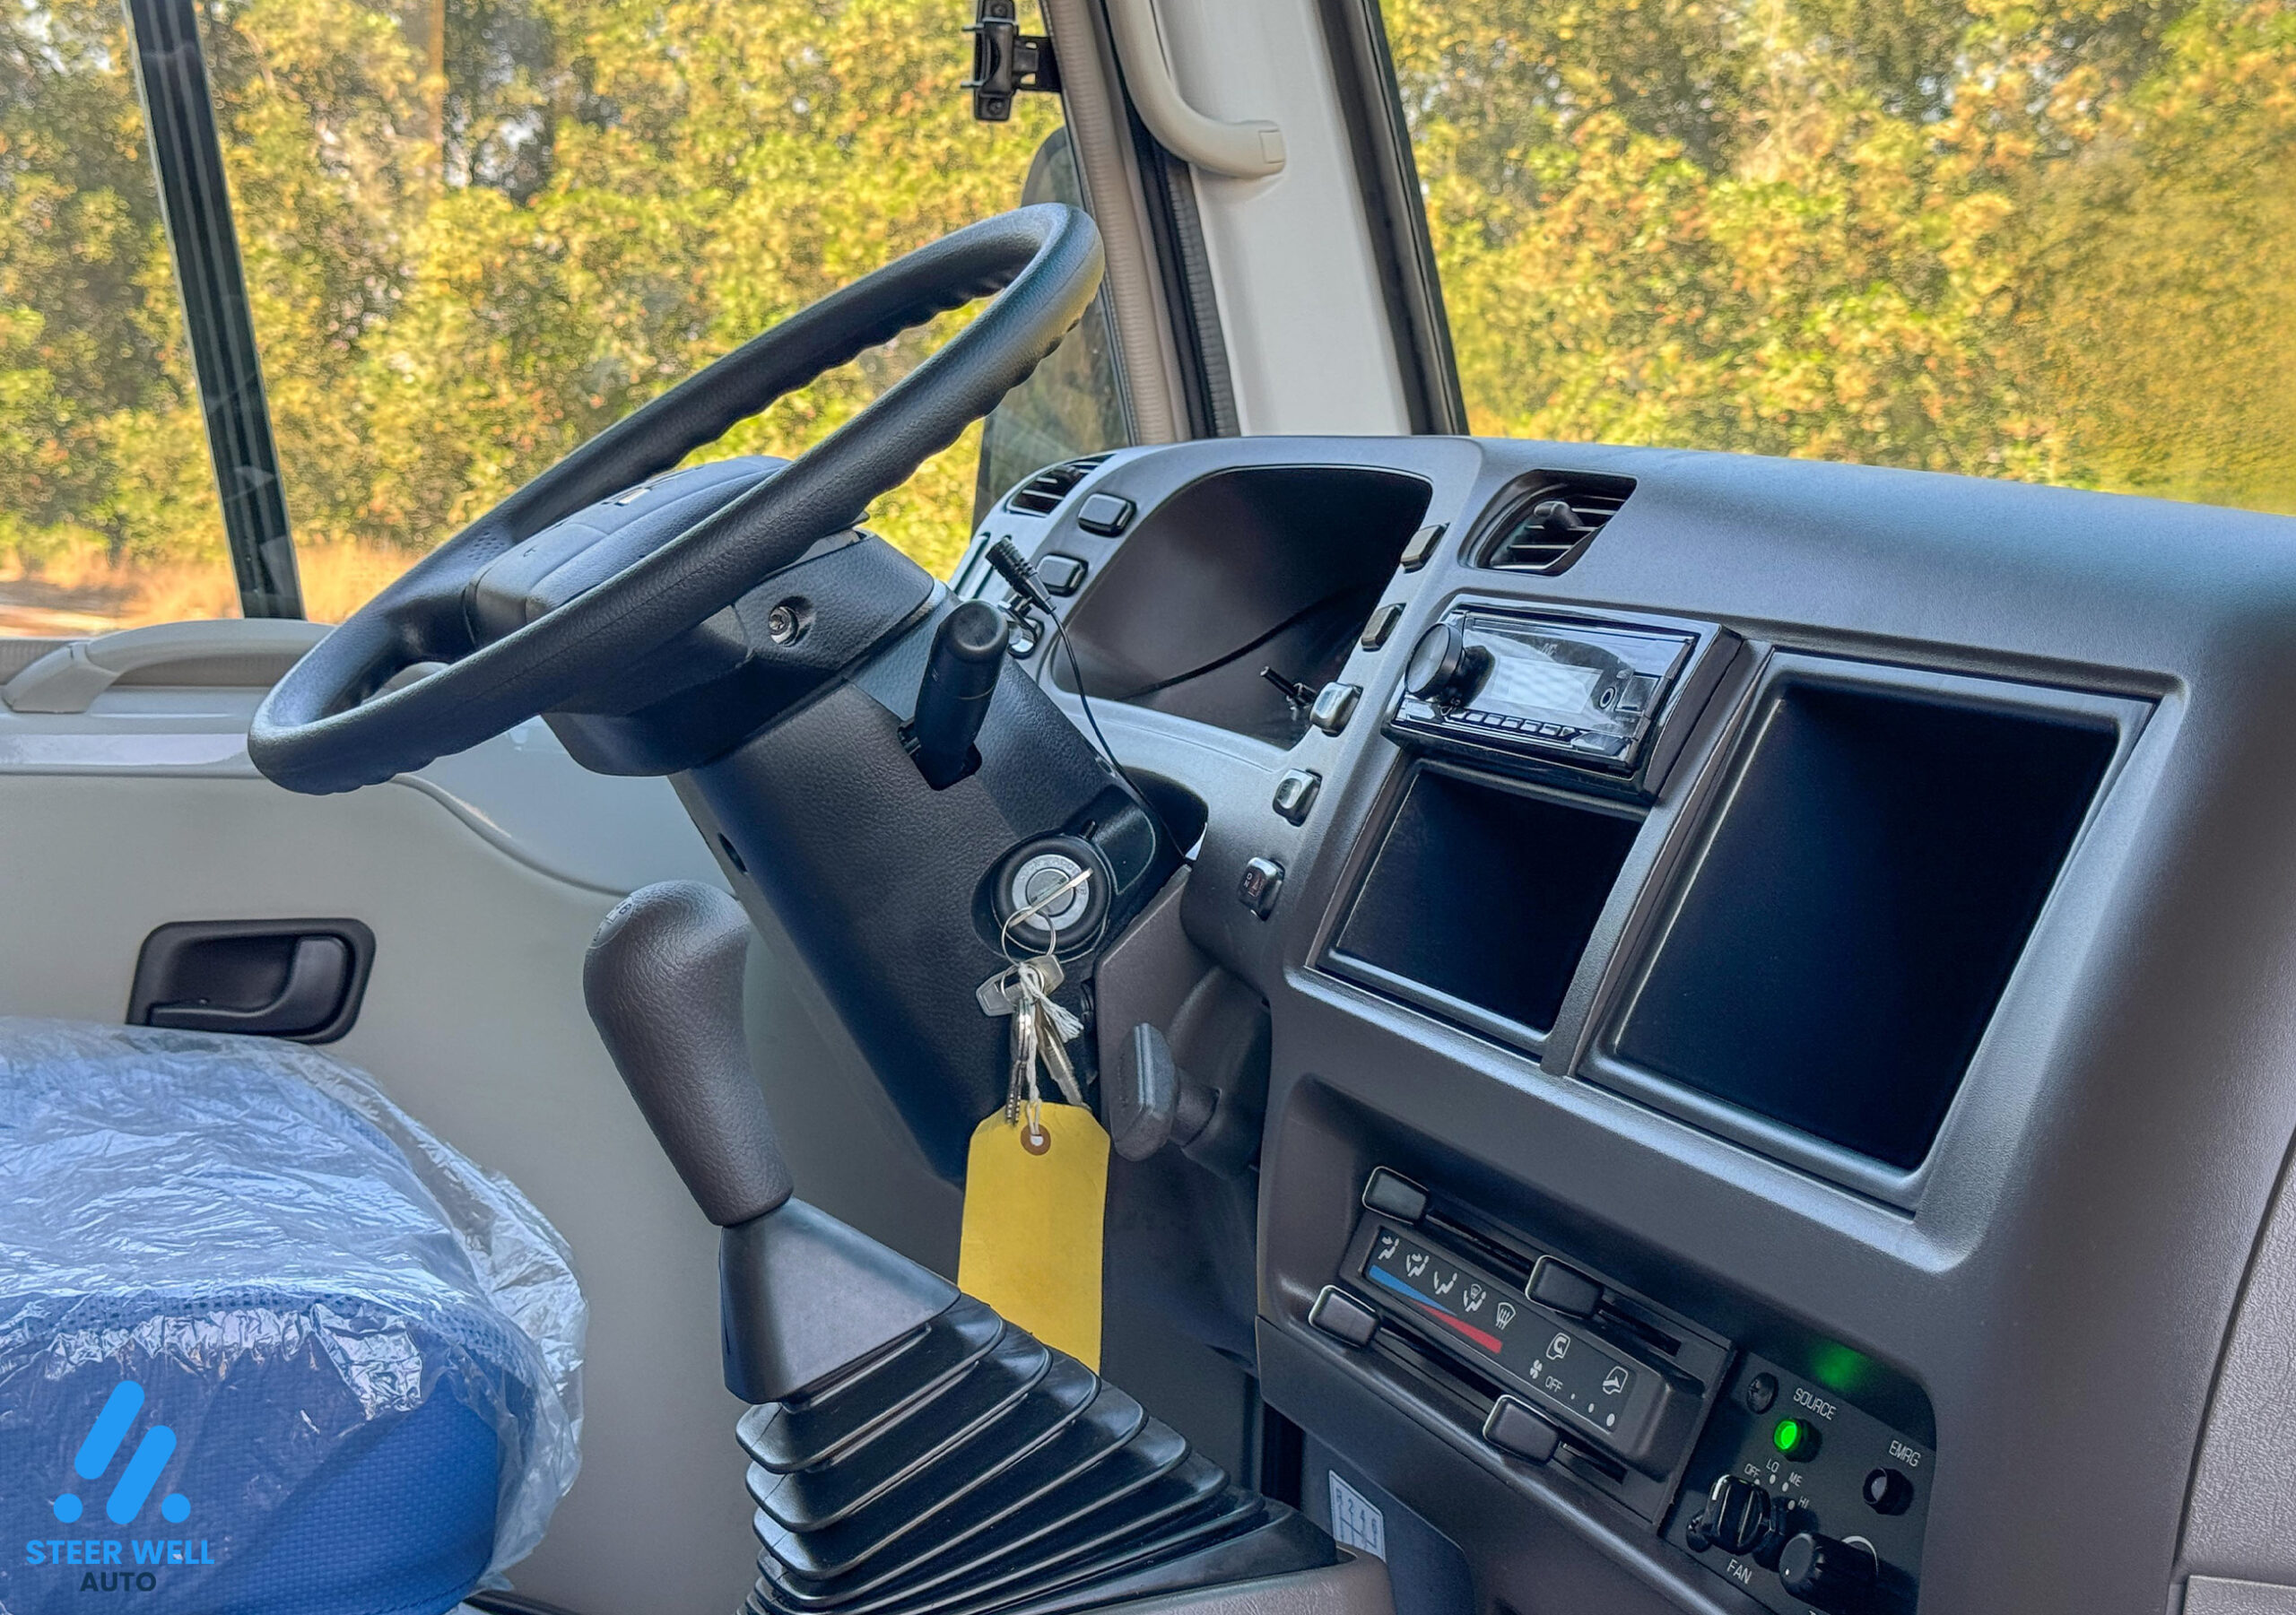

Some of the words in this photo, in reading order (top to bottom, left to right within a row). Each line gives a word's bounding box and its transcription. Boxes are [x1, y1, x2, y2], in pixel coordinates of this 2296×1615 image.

[1544, 1376, 1563, 1393] OFF
[1793, 1387, 1837, 1421] SOURCE
[1888, 1439, 1921, 1467] EMRG
[1744, 1463, 1761, 1478] OFF
[1765, 1458, 1780, 1473] LO
[1788, 1472, 1803, 1488] ME
[1797, 1496, 1810, 1509] HI
[1726, 1559, 1752, 1585] FAN
